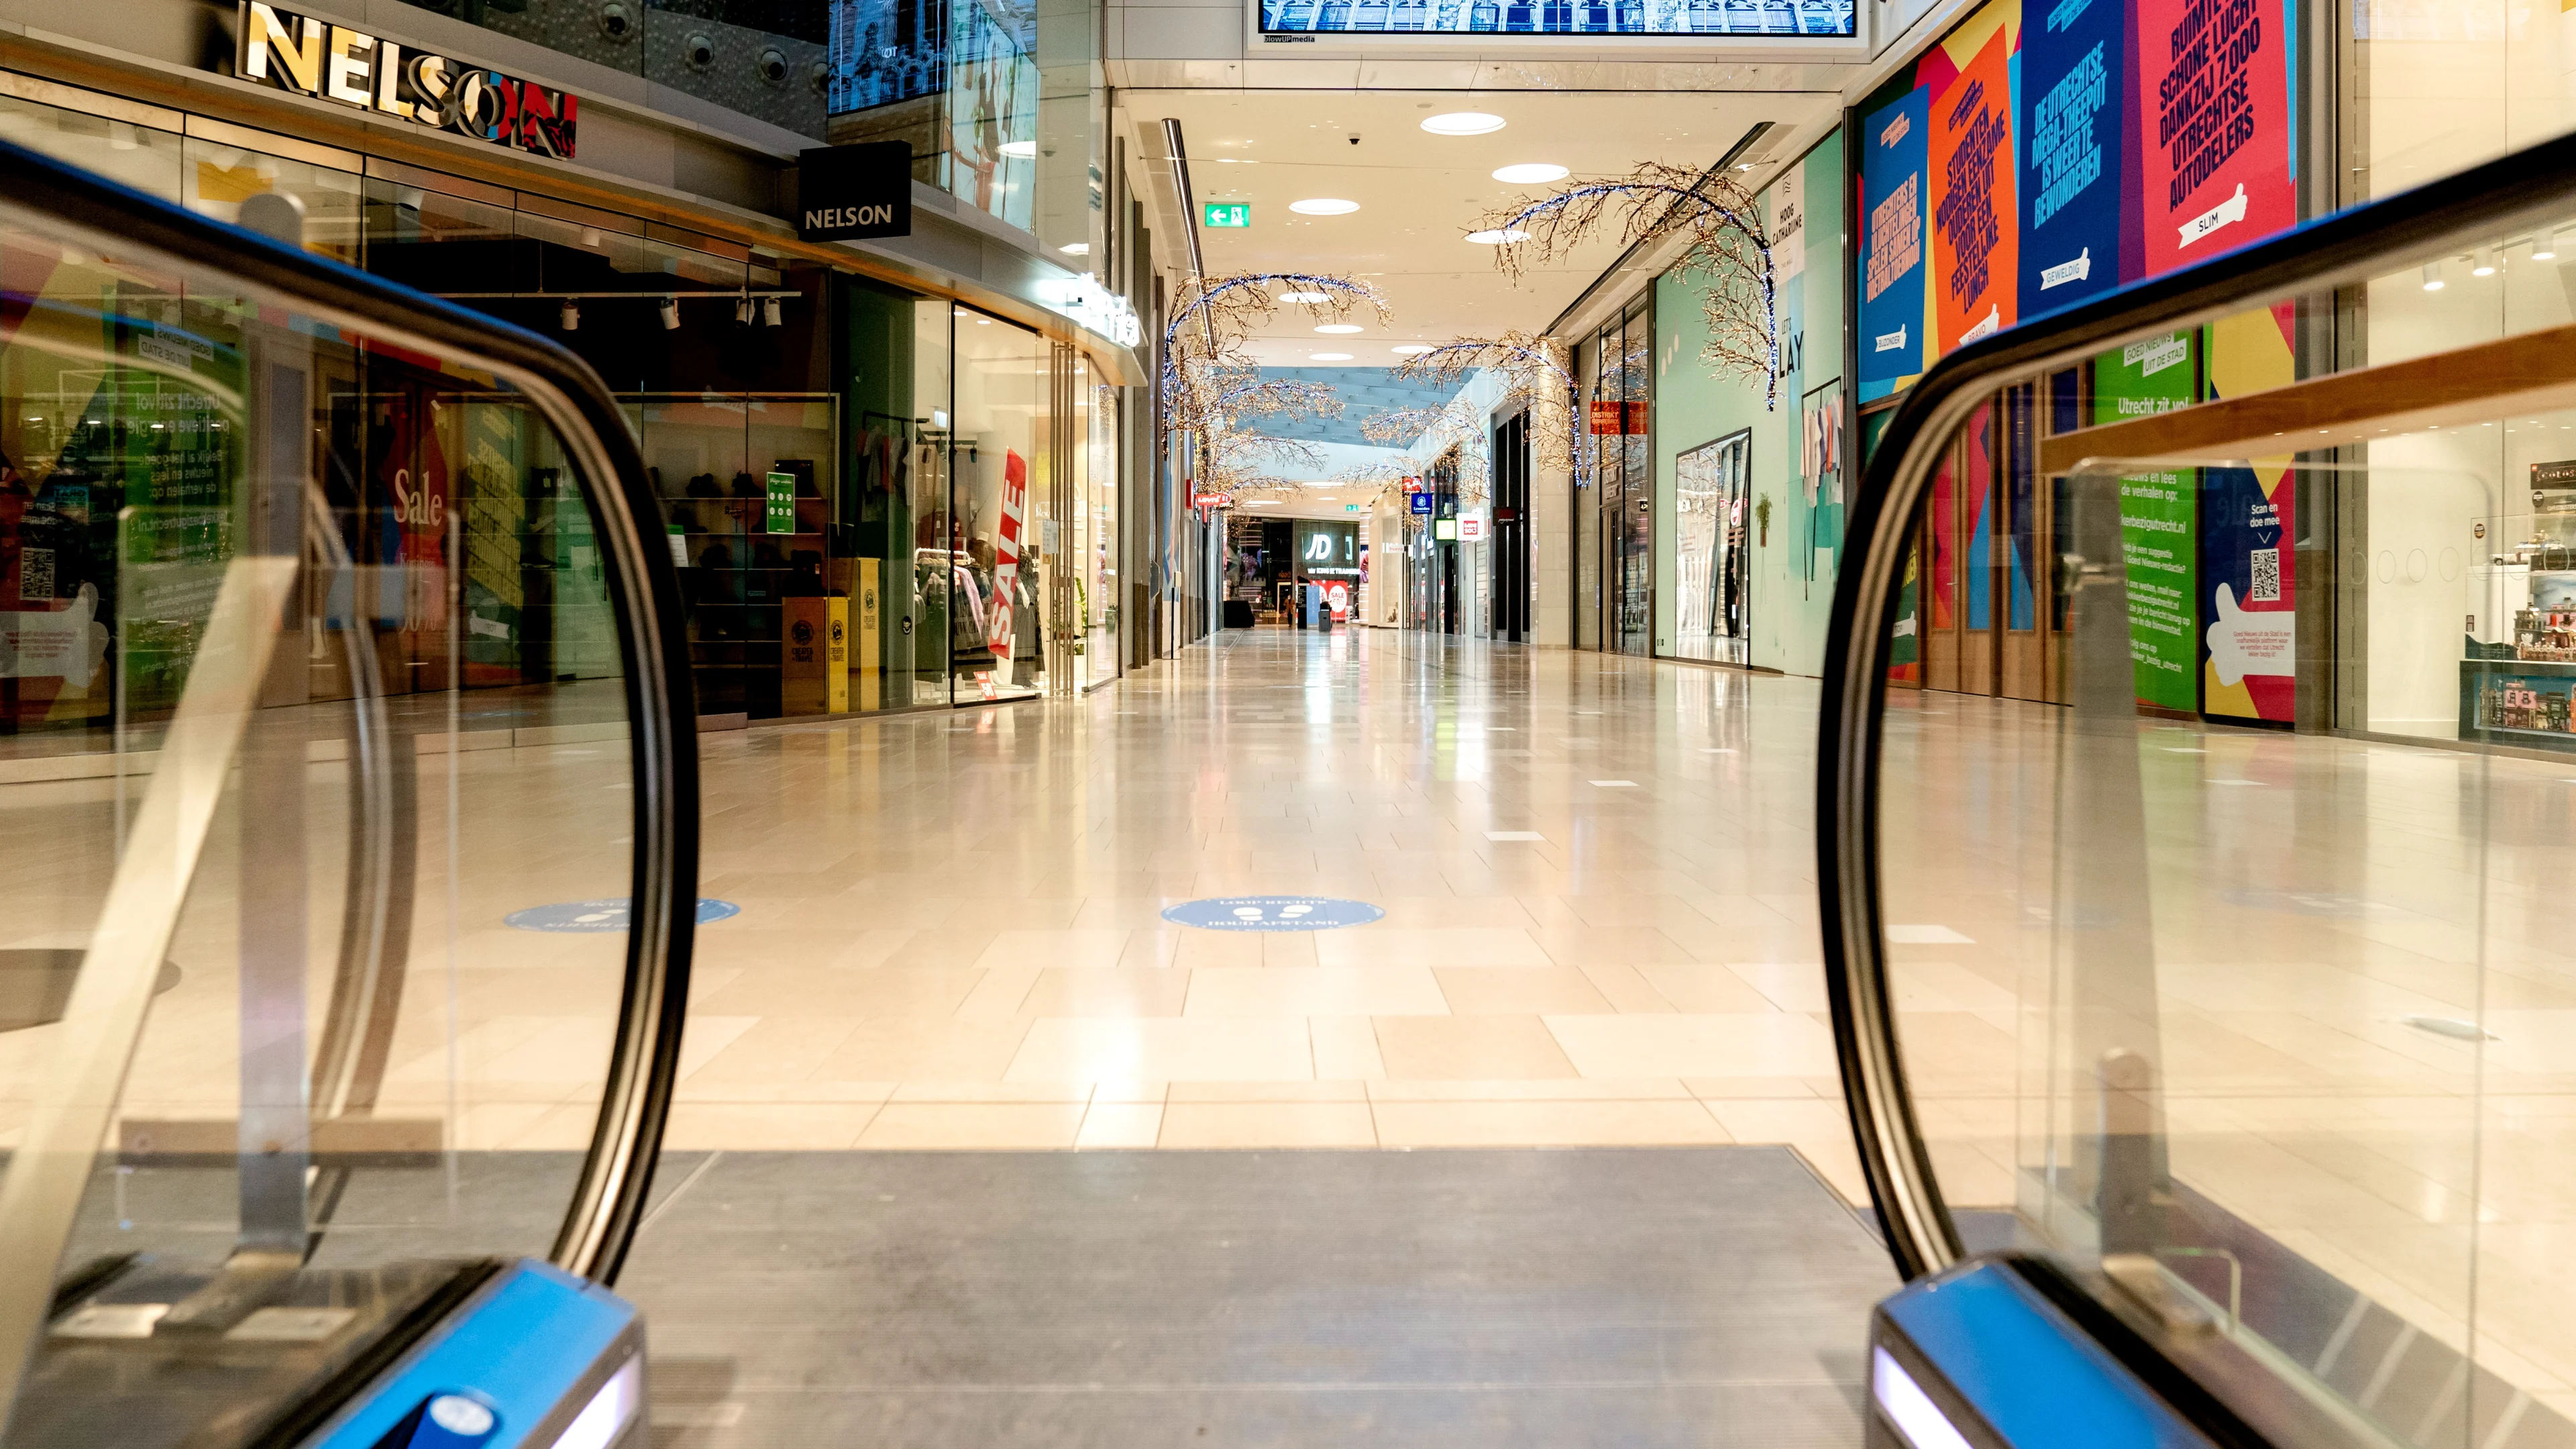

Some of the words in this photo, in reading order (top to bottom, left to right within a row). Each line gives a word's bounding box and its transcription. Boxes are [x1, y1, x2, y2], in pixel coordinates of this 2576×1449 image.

[2049, 9, 2062, 27] GOED
[2071, 6, 2078, 18] DE
[244, 1, 578, 160] NELSON
[2160, 31, 2210, 111] SCHONE
[2160, 63, 2214, 150] DANKZIJ
[2217, 17, 2261, 89] 7.000
[2035, 96, 2047, 137] DE
[2047, 40, 2104, 122] UTRECHTSE
[2032, 70, 2107, 170] MEGA-THEEPOT
[2172, 68, 2249, 171] UTRECHTSE
[1947, 102, 1989, 188] STUDENTEN
[2169, 104, 2254, 213] AUTODELERS
[1936, 168, 1967, 235] NODIGEN
[1968, 109, 2006, 187] EENZAME
[2034, 143, 2101, 230] BEWONDEREN
[2042, 156, 2051, 193] IS
[805, 204, 892, 230] NELSON
[1780, 203, 1794, 224] HOOG
[1872, 180, 1908, 233] UTRECHTERS
[1909, 171, 1917, 197] EN
[1948, 176, 1981, 246] OUDEREN
[1983, 155, 1994, 195] UIT
[1772, 214, 1802, 246] CATHARIJNE
[1912, 215, 1921, 243] OP
[1955, 216, 1976, 265] VOOR
[1978, 191, 1992, 236] EEN
[2199, 212, 2218, 232] SLIM
[1951, 213, 1999, 301] FEESTELIJKE
[2047, 263, 2080, 283] GEWELDIG
[1963, 258, 1989, 315] LUNCH
[1782, 317, 1791, 335] LET'S
[1878, 335, 1900, 347] BIJZONDER
[1968, 325, 1986, 343] BRAVO
[1779, 330, 1804, 378] LAY
[2127, 344, 2145, 361] GOED
[2145, 358, 2155, 372] UIT
[2157, 354, 2165, 366] DE
[2167, 347, 2184, 362] STAD
[2118, 396, 2155, 415] Utrecht
[2157, 396, 2169, 413] zit
[2121, 484, 2131, 496] de
[2132, 486, 2163, 499] verhalen
[2161, 472, 2177, 484] lees
[394, 468, 443, 527] Sale
[2251, 504, 2267, 515] Scan
[2269, 503, 2278, 513] en
[2250, 517, 2263, 527] doe
[2265, 517, 2280, 526] mee
[991, 479, 1024, 647] SALE
[1305, 534, 1332, 560] JD
